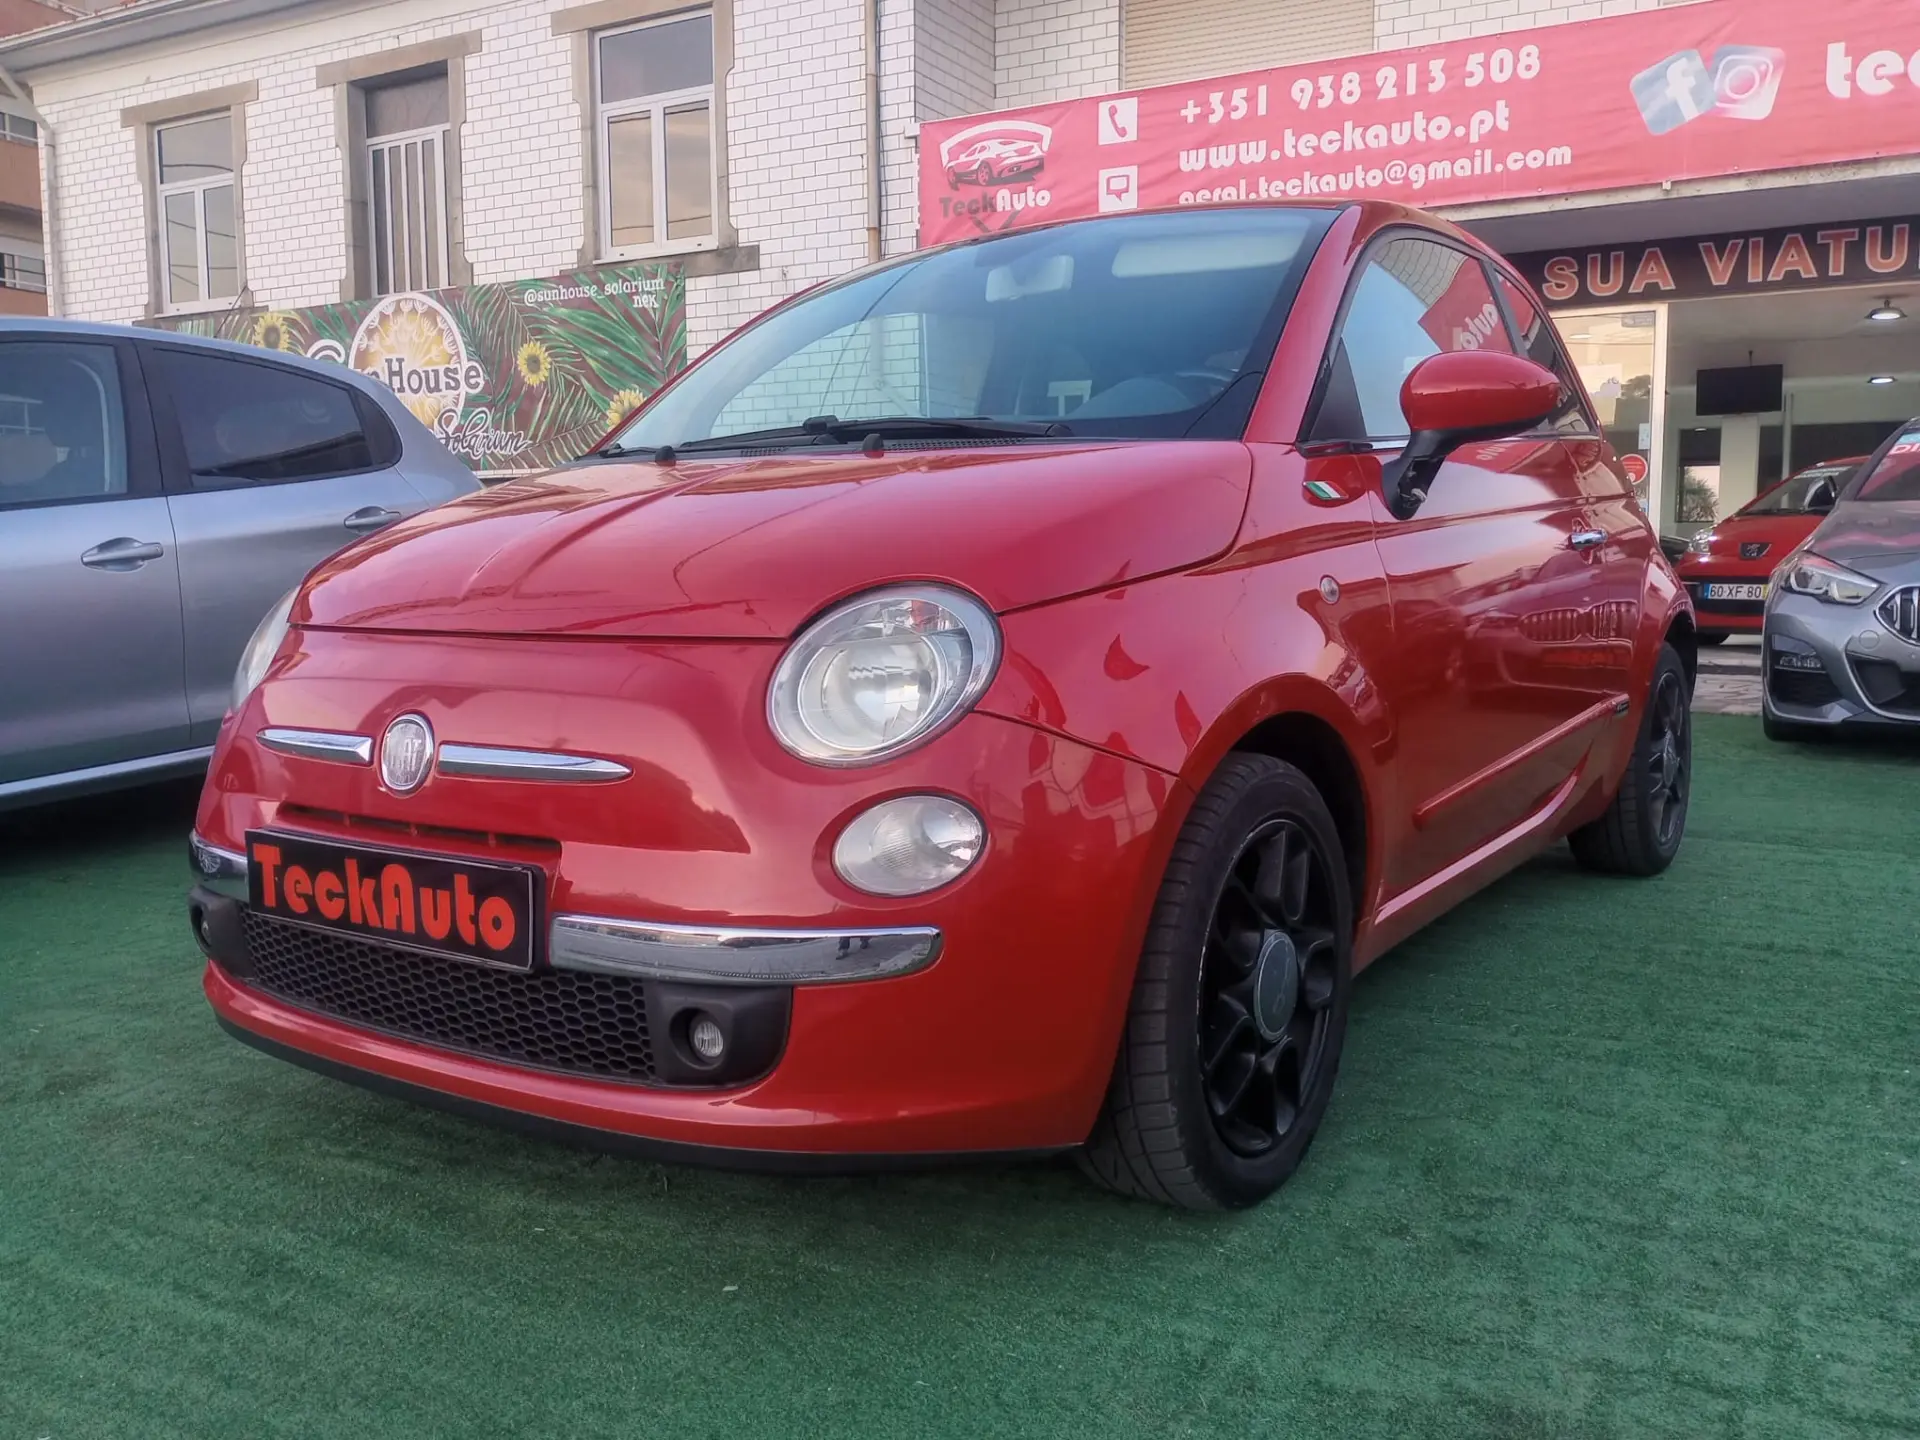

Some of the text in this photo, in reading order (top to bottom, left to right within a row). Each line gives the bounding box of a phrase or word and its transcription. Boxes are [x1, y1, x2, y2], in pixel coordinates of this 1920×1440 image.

[1179, 44, 1541, 123] +351 938 213 508
[1179, 99, 1510, 172] www.teckauto.pt
[939, 185, 1051, 218] TeckAuto
[524, 277, 665, 307] @sunhouse_solarium
[1542, 223, 1920, 300] SUA VIATU
[1710, 585, 1762, 599] 60 XF 80
[253, 843, 516, 951] TeckAuto
